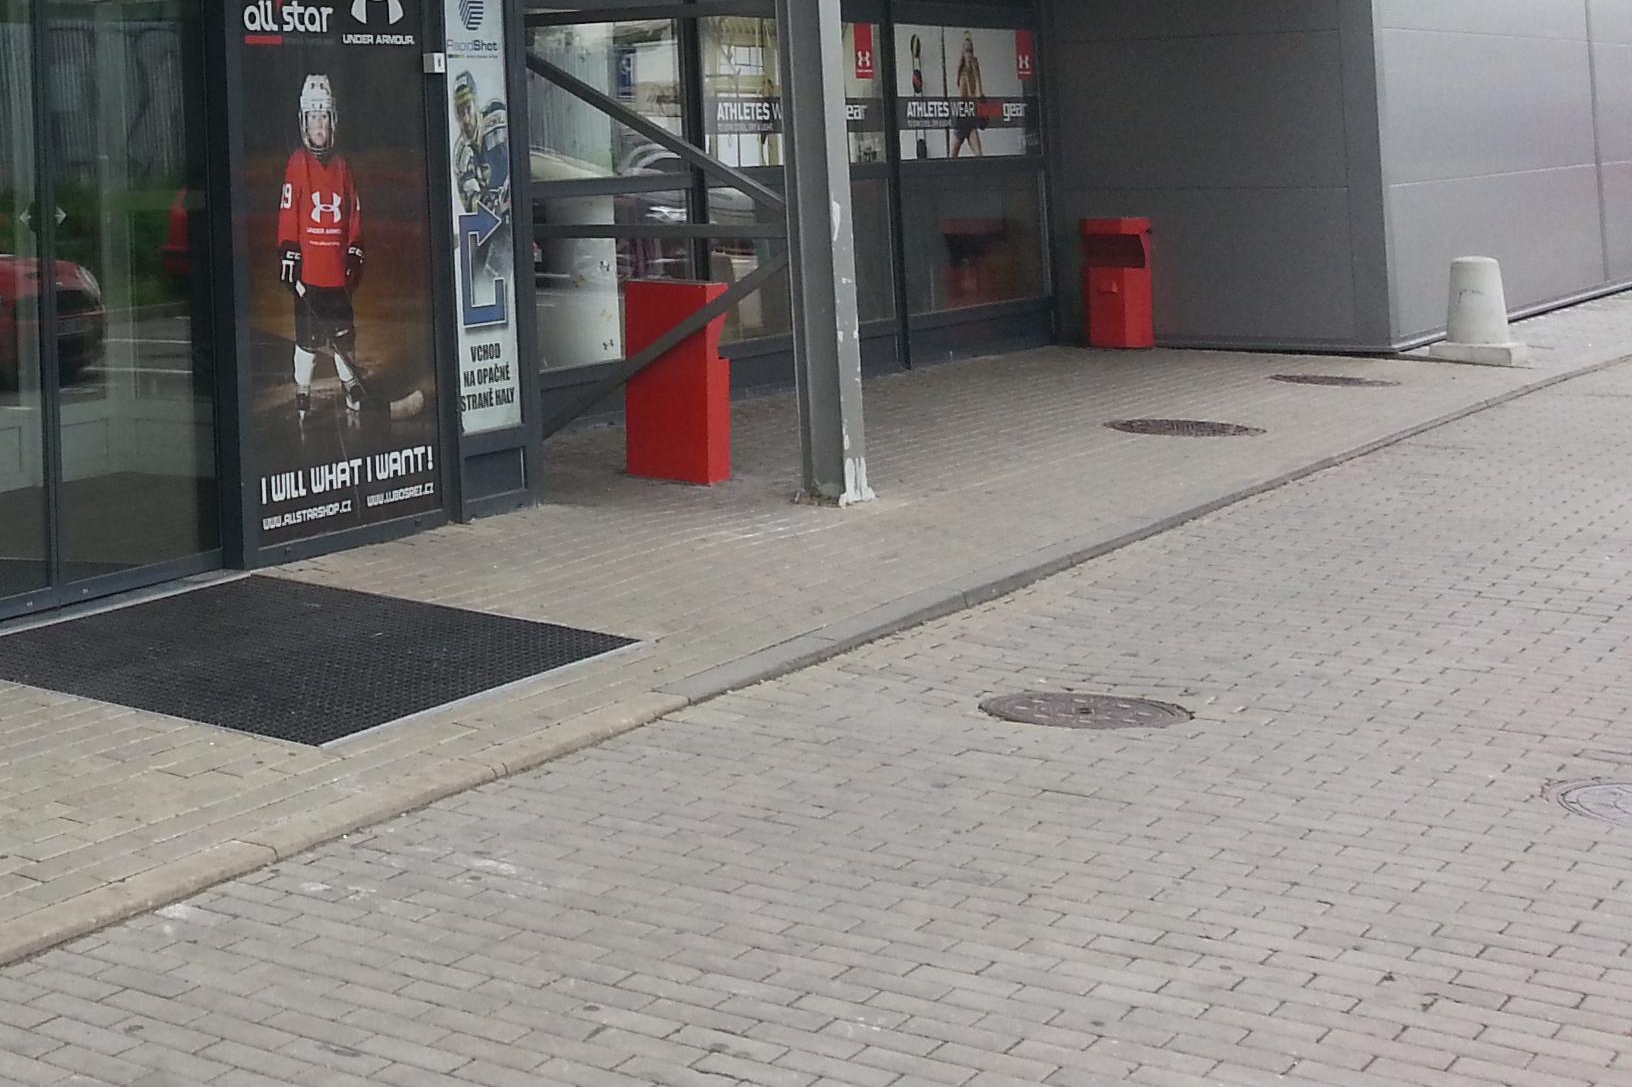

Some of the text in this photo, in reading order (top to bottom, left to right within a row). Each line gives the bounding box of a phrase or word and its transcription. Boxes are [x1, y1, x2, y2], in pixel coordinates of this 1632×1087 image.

[243, 0, 334, 33] all star
[342, 34, 374, 45] UNDER
[717, 101, 770, 121] ATHLETES
[906, 101, 949, 118] ATHLETES
[949, 101, 975, 118] WEAR
[470, 342, 501, 363] VCHOD
[463, 361, 510, 388] NA OPAČNÉ
[460, 386, 515, 413] STRANĚ HALY
[261, 445, 434, 505] I WILL WHAT I WANT!
